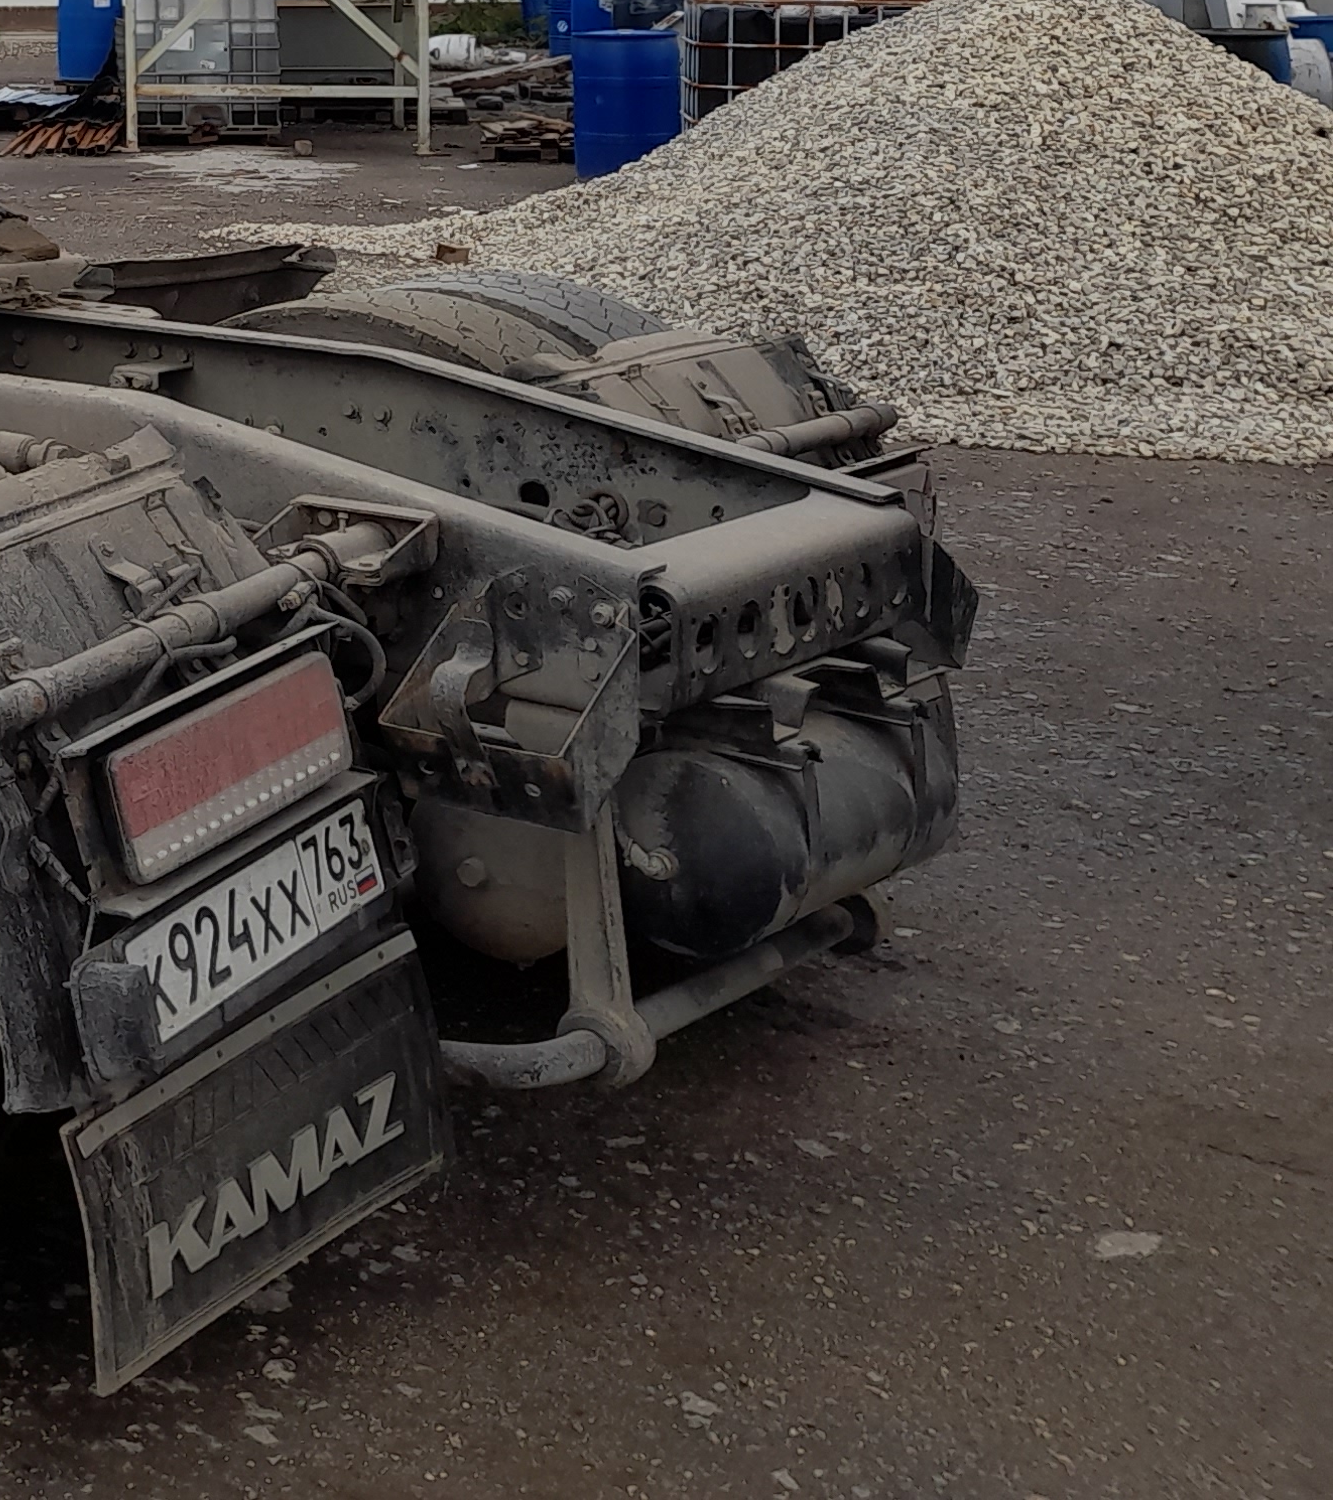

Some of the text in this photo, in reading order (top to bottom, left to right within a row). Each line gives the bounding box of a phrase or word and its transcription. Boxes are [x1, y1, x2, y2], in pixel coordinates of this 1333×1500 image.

[300, 811, 364, 896] 763
[327, 881, 358, 913] RUS
[144, 1071, 406, 1300] KAMAZ
